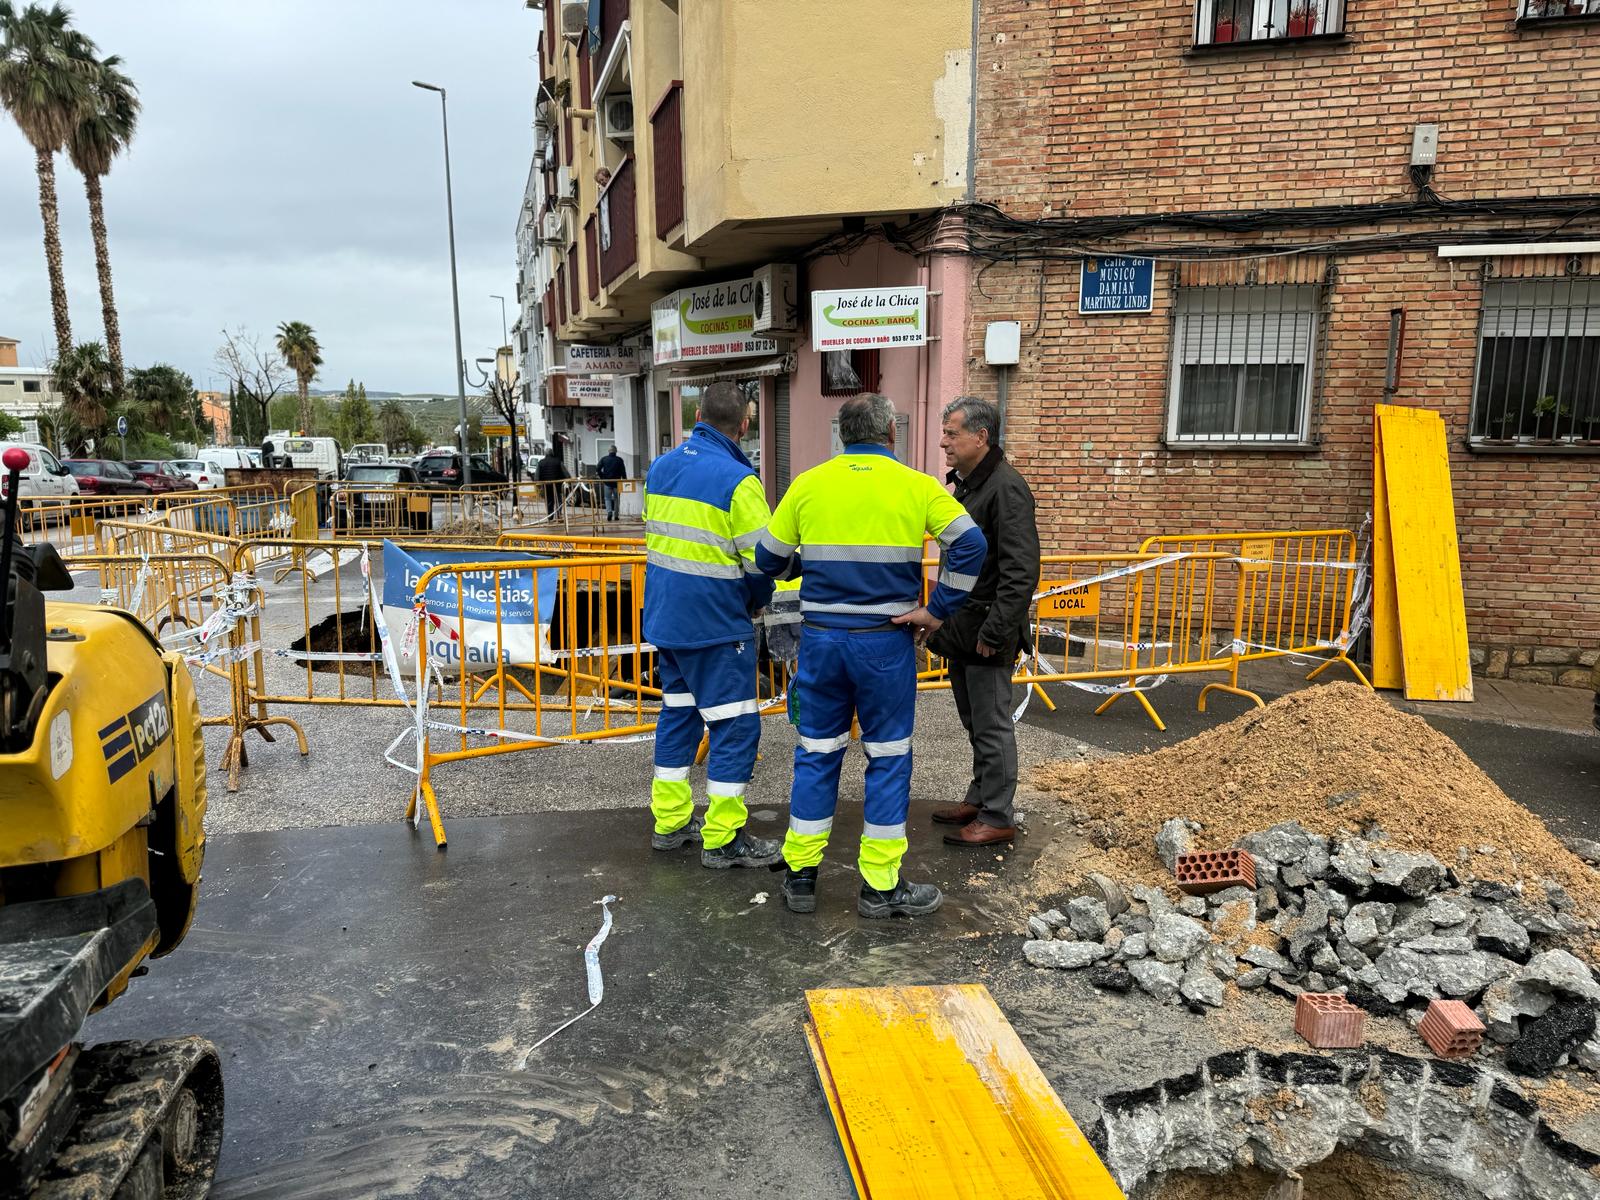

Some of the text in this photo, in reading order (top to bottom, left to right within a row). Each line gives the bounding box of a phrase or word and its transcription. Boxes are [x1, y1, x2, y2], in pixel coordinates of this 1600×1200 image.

[1104, 258, 1145, 267] Calle del
[1100, 267, 1135, 281] MUSICO
[1099, 282, 1135, 295] DAMIAN
[690, 290, 710, 314] José
[713, 287, 724, 307] de
[727, 286, 737, 306] la
[740, 281, 755, 304] Ch
[837, 294, 919, 311] José de la Chica
[1084, 295, 1148, 310] MARTINEZ LINDE
[700, 322, 729, 333] COCINAS
[738, 317, 753, 330] BAÑ
[842, 318, 879, 327] COCINAS
[681, 346, 702, 357] MUEBLES
[702, 345, 709, 355] DE
[709, 344, 726, 354] COCINA
[726, 344, 730, 353] Y
[730, 341, 743, 353] BAÑO
[745, 341, 754, 352] 953
[755, 341, 763, 350] 87
[763, 340, 768, 350] 12
[769, 340, 776, 350] 24
[821, 338, 845, 346] MUEBLES
[570, 347, 611, 359] CAFETERIA
[617, 347, 634, 359] BAR
[585, 360, 623, 371] AMARO
[404, 568, 535, 607] la mlestias,
[1053, 598, 1086, 609] LOCAL
[429, 639, 512, 665] qualia
